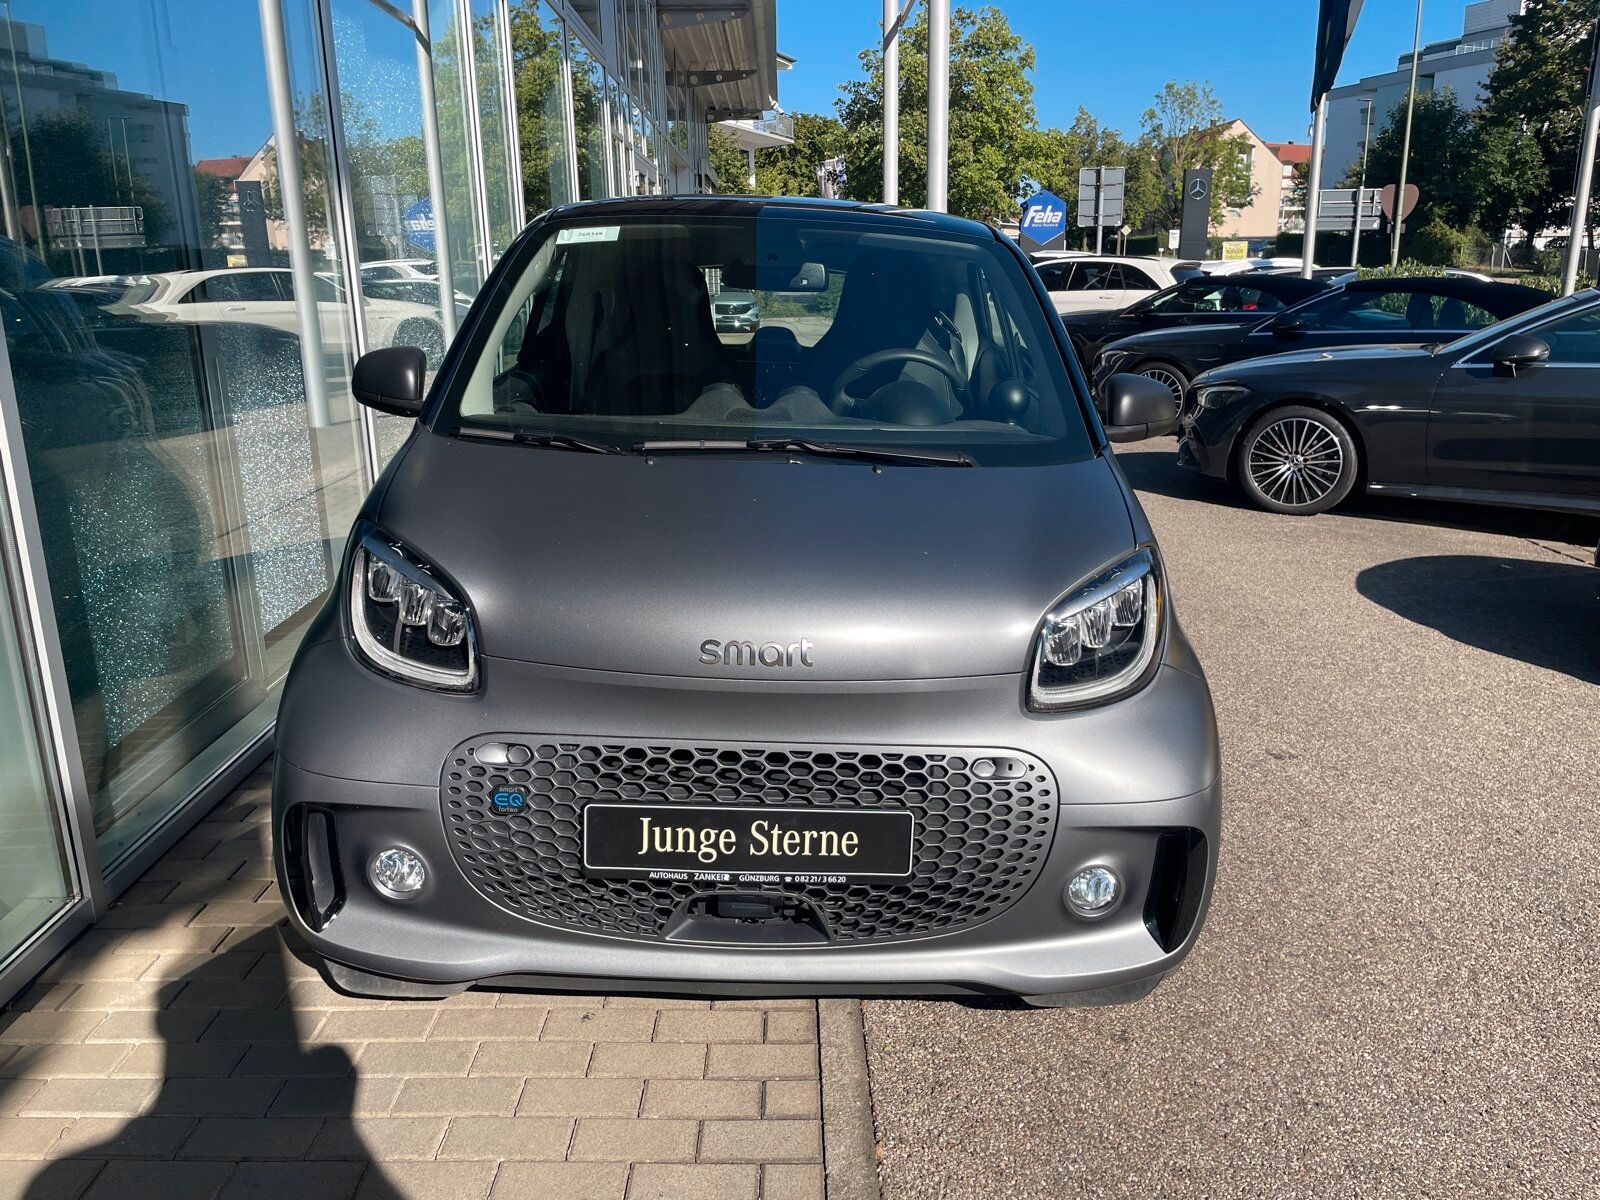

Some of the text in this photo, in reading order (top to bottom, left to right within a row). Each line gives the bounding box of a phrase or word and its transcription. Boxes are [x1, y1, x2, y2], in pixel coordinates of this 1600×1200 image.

[1023, 205, 1063, 228] Feha
[698, 638, 814, 668] smart
[494, 793, 523, 807] EQ
[638, 817, 859, 863] Junge Sterne
[649, 871, 688, 880] AUTOHAUS
[738, 874, 780, 882] GÜNZBURG
